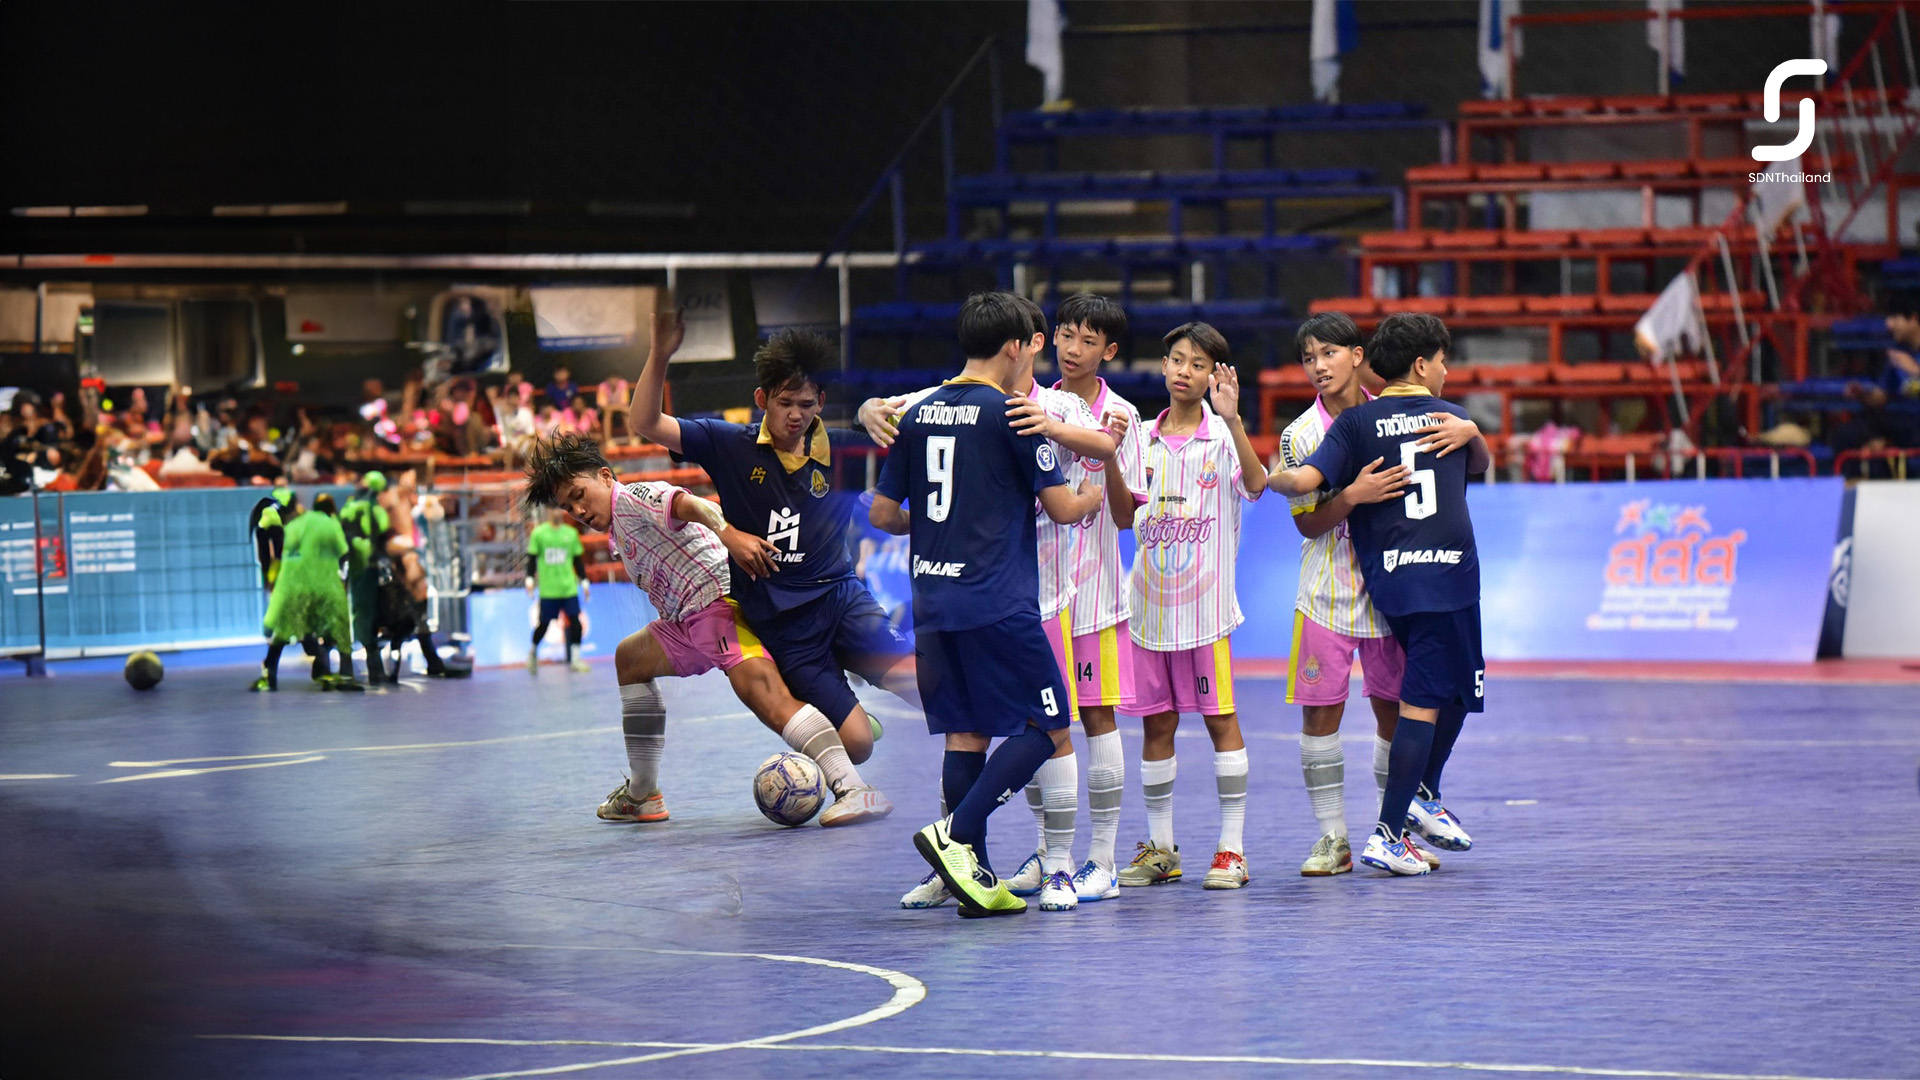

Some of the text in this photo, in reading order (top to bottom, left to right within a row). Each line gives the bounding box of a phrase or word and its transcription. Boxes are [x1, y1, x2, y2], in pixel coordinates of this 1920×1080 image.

[926, 435, 957, 523] 9
[1400, 440, 1438, 520] 5
[1398, 549, 1463, 566] IMANE
[1077, 661, 1093, 682] 14
[1196, 676, 1209, 695] 10
[1474, 669, 1484, 698] 5
[1040, 686, 1060, 717] 9
